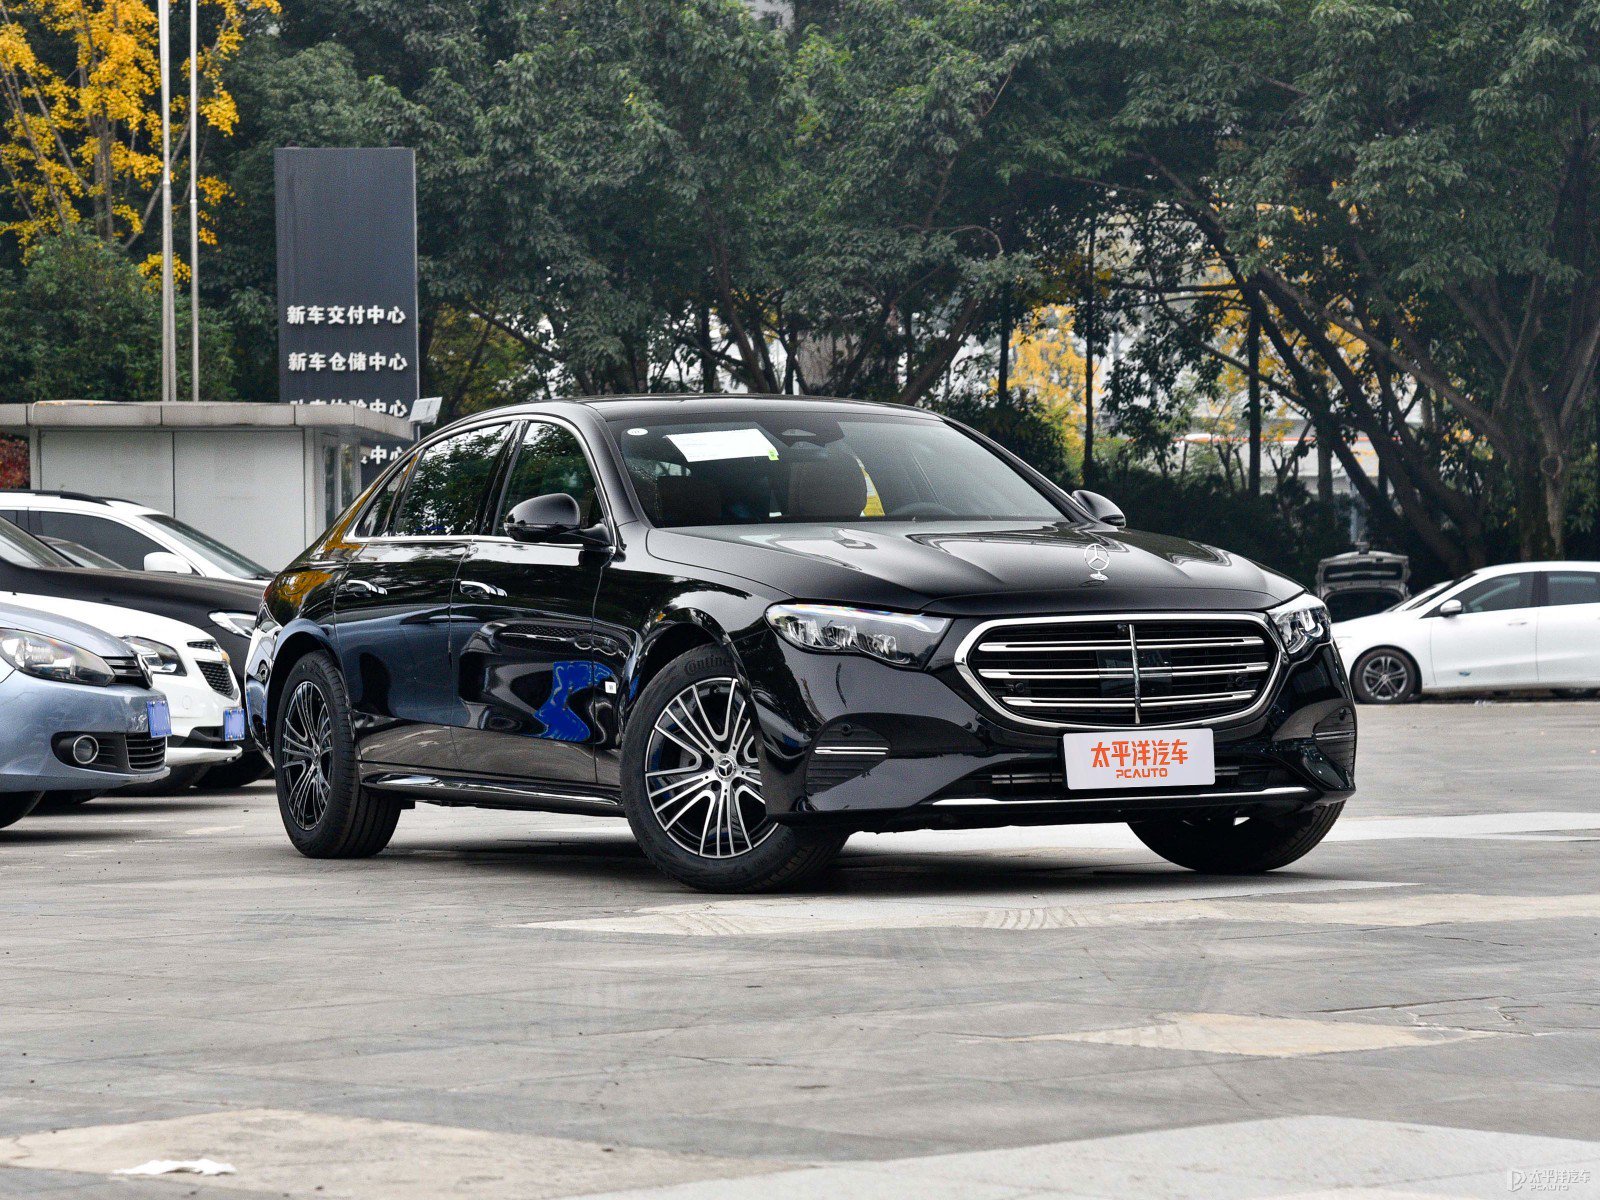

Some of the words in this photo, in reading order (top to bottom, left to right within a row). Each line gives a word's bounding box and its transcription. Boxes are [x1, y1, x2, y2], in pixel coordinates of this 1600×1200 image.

[286, 305, 406, 325] 新车交付中心
[288, 352, 408, 372] 新车仓储中心
[1090, 739, 1188, 768] 太平洋汽车
[1115, 767, 1169, 779] PCAUTO
